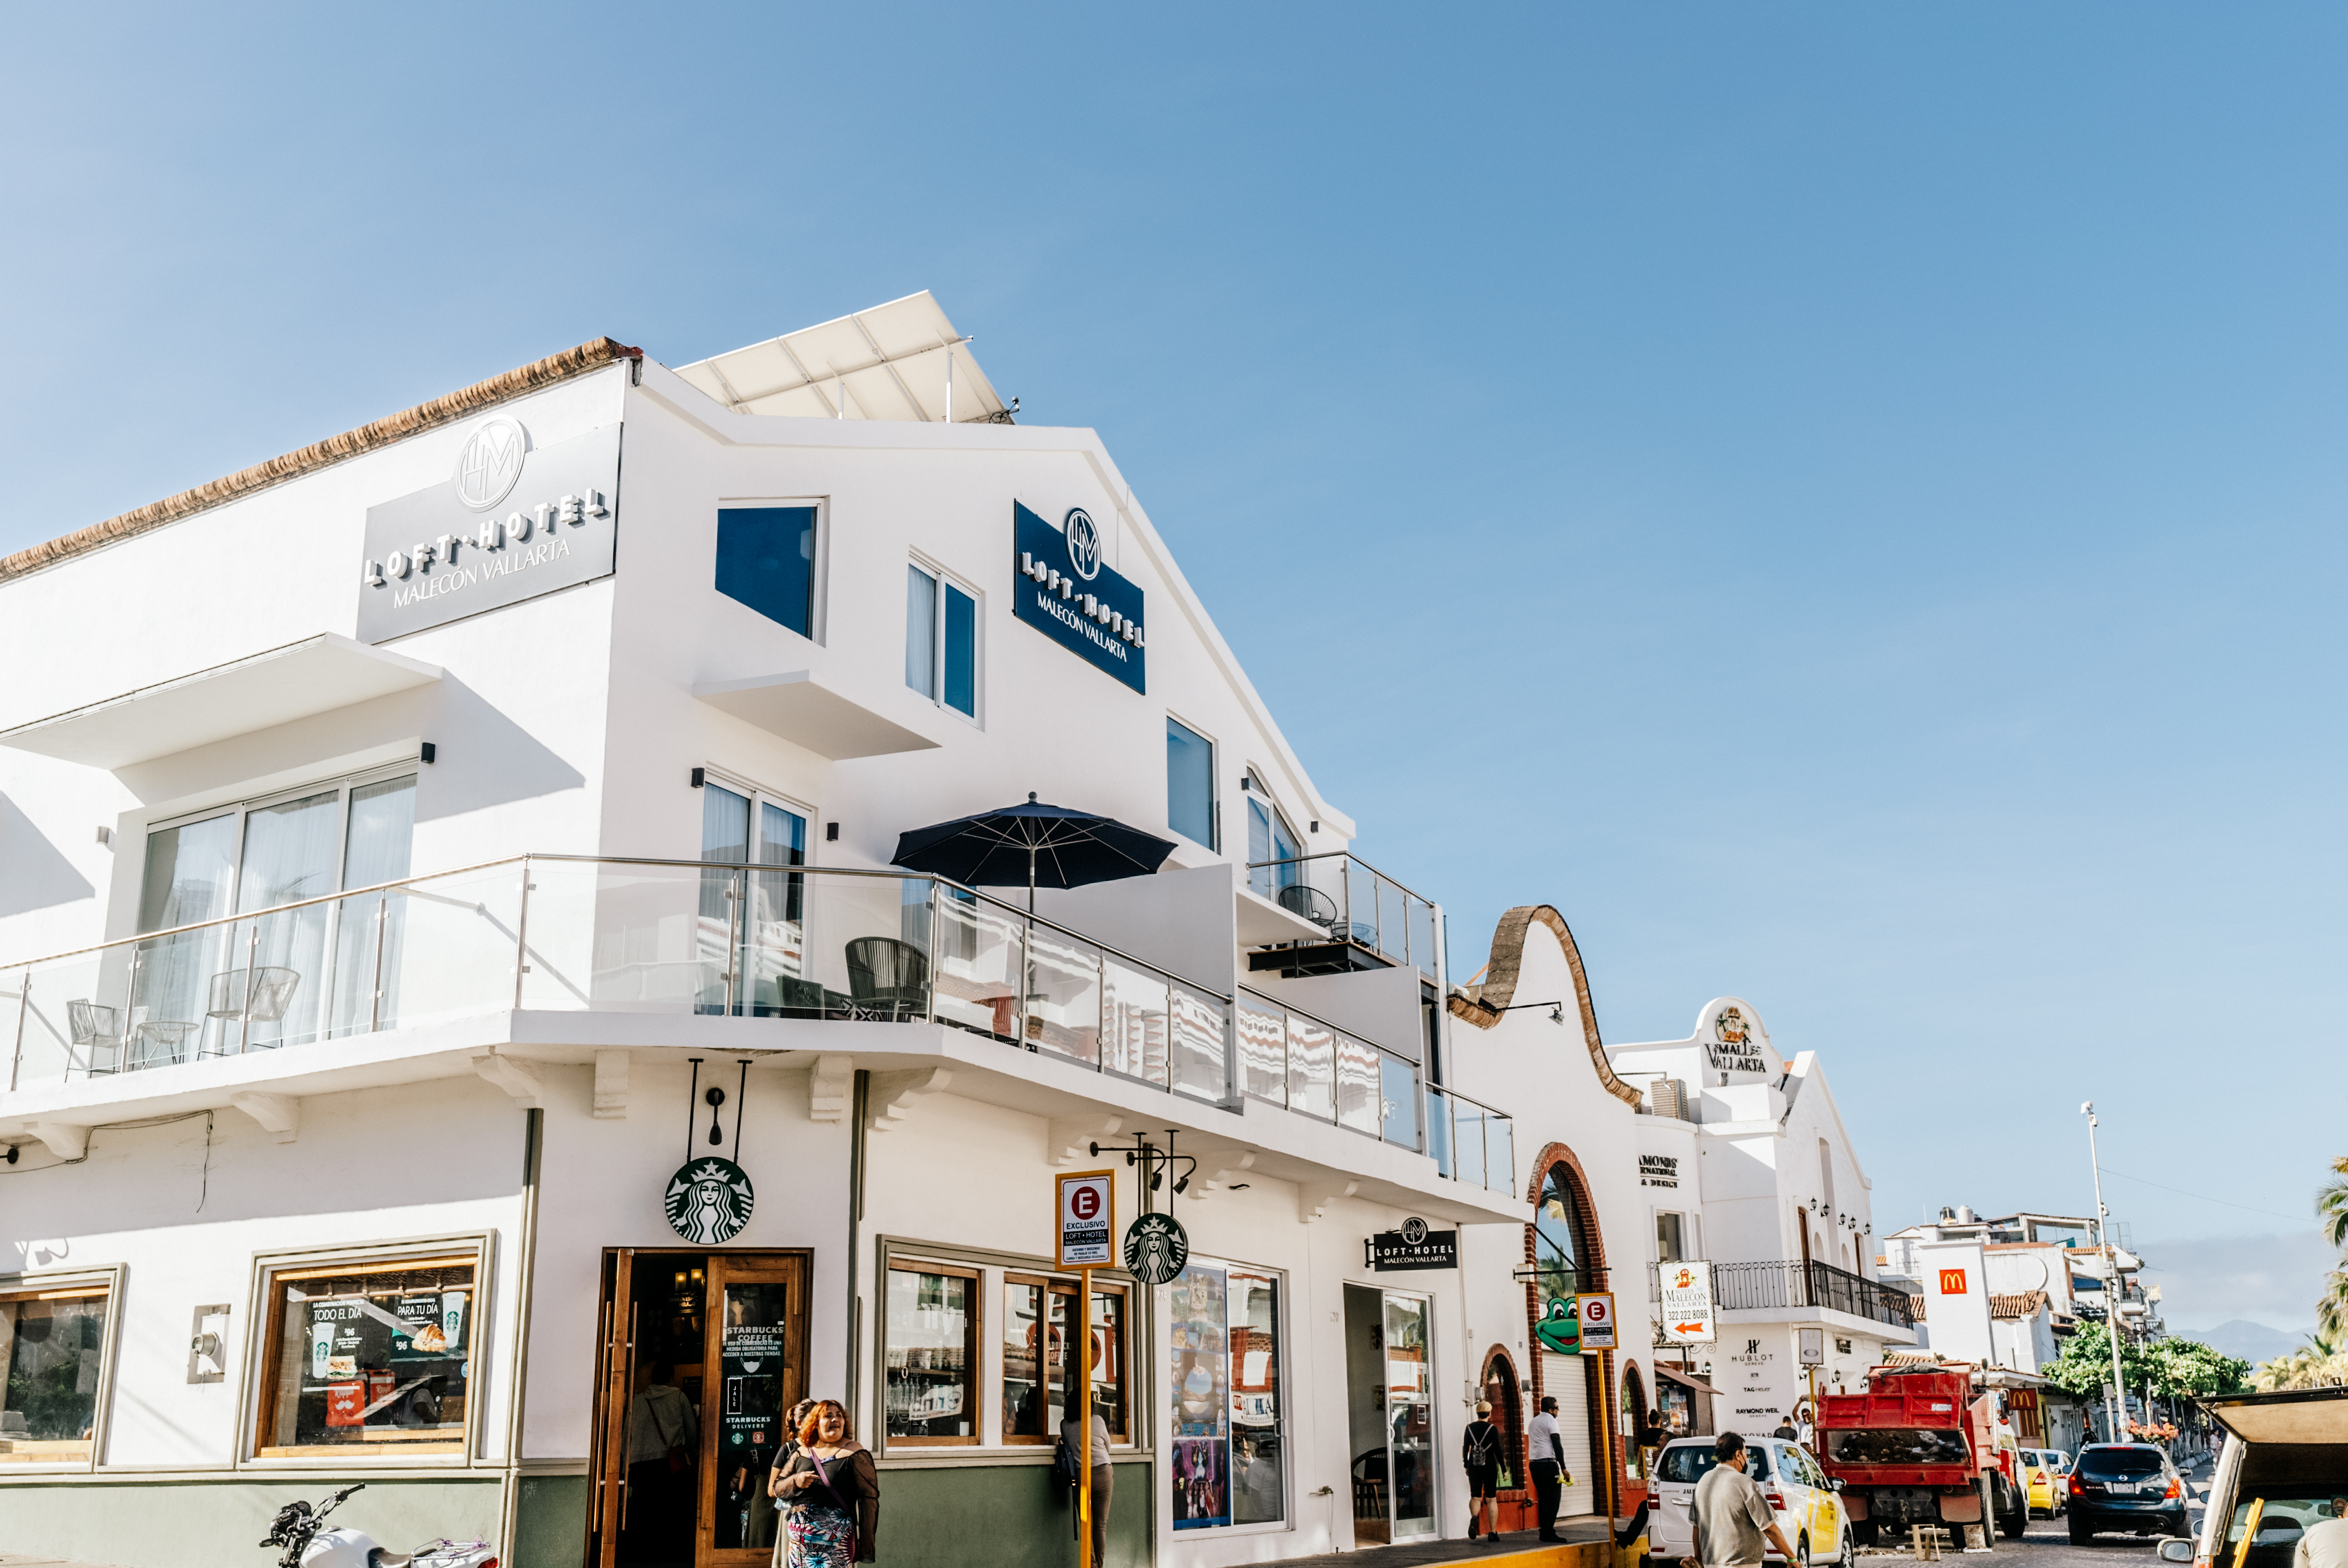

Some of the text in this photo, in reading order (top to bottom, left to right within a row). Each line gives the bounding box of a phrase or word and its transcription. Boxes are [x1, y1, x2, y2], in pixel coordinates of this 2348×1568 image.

[364, 488, 606, 586] LOFT HOTEL
[394, 538, 570, 609] MALECÓN VALLARTA
[1022, 552, 1145, 648] LOFT HOTEL
[1038, 591, 1127, 662] MALECÓN VALLARTA
[1705, 1044, 1766, 1072] VALLARTA
[1651, 1179, 1677, 1188] DESIGN
[1079, 1192, 1093, 1214] E
[1066, 1220, 1105, 1229] EXCLUSIVO
[1377, 1245, 1454, 1256] LOFT HOTEL
[314, 1306, 362, 1321] TODO EL DÍA
[398, 1303, 438, 1316] PARA TU DÍA
[1591, 1305, 1601, 1318] E
[1668, 1309, 1708, 1321] 322 222 8088
[344, 1328, 355, 1336] $96
[396, 1341, 408, 1350] $96
